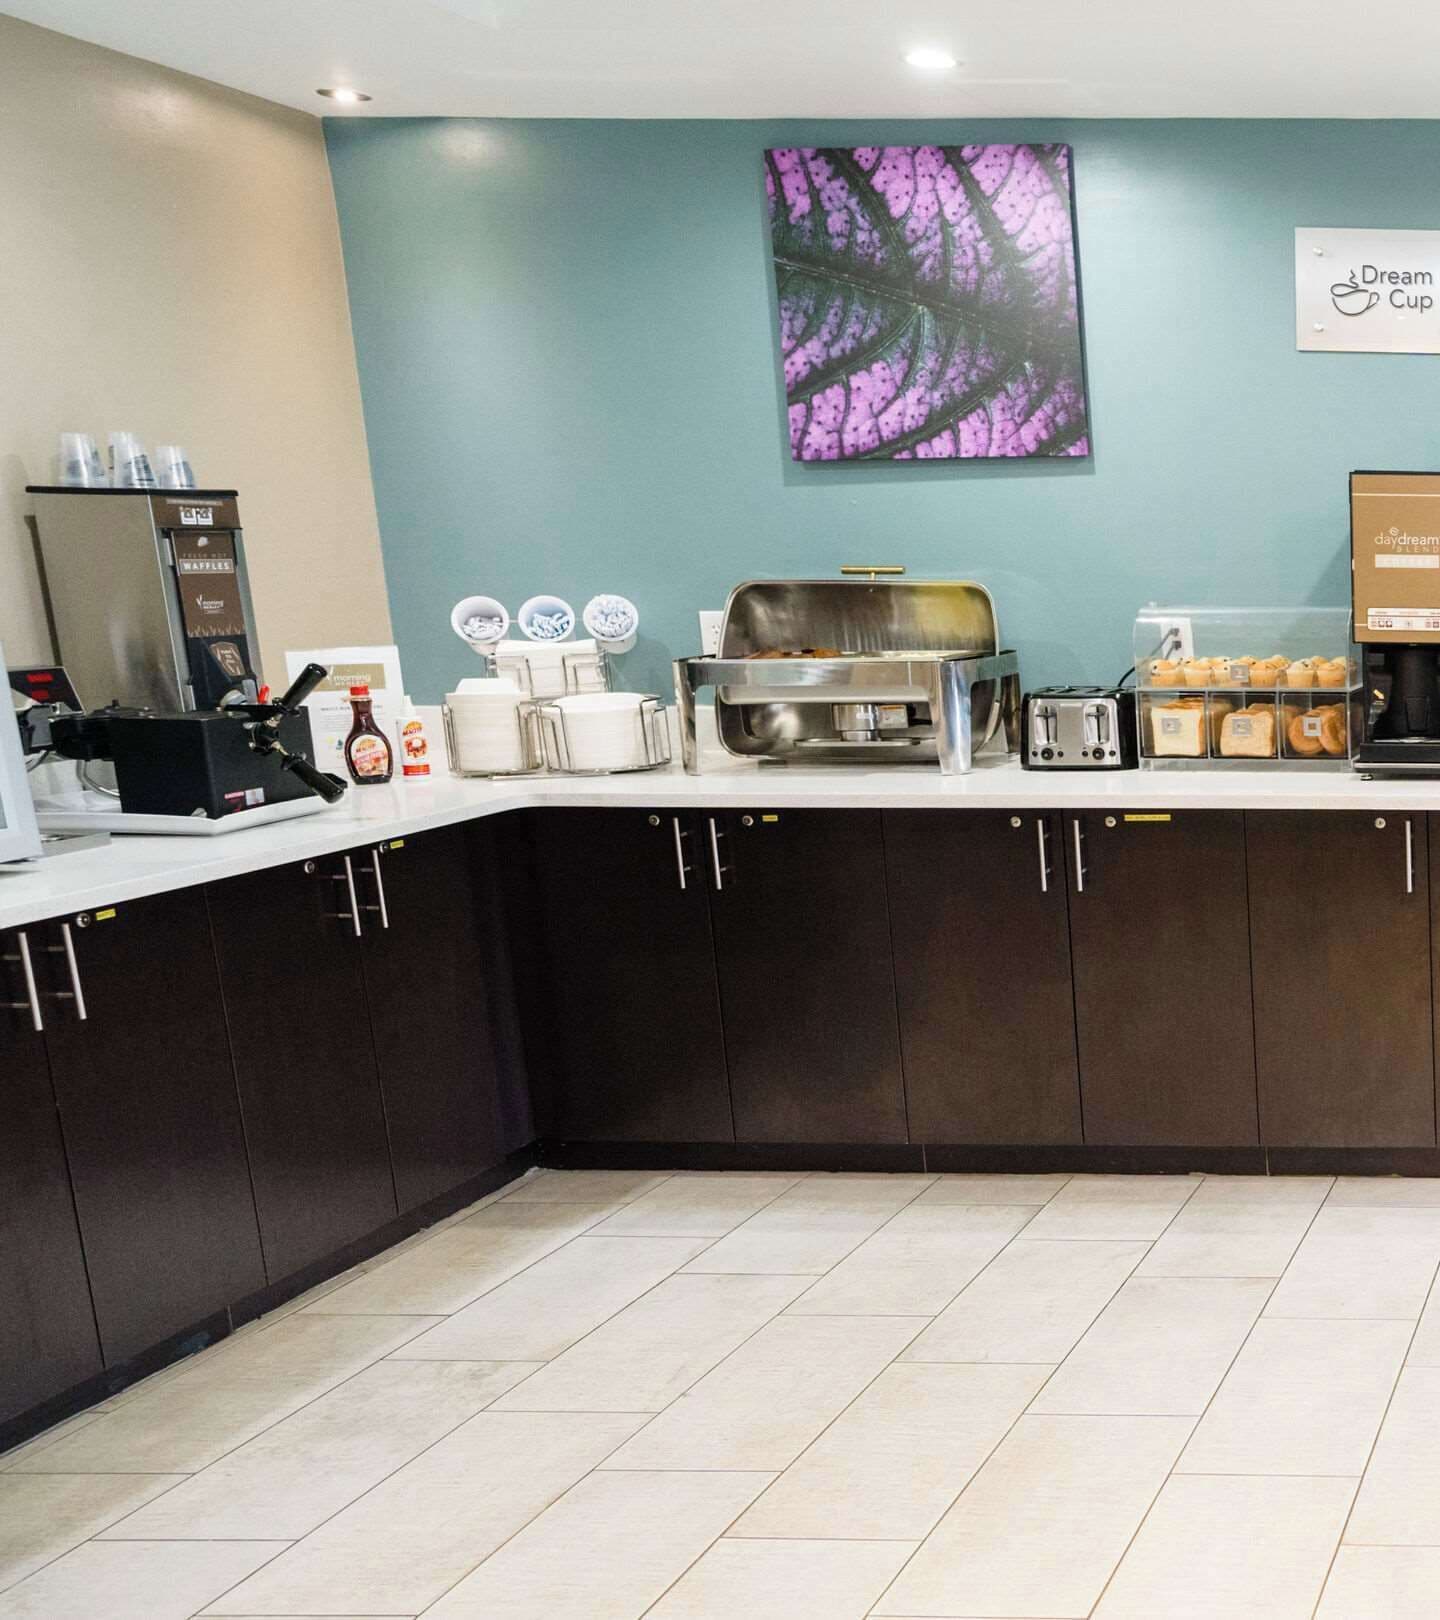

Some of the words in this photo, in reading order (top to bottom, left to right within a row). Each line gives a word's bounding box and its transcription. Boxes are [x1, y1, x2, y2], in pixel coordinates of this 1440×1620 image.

[1362, 264, 1433, 285] Dream
[1389, 288, 1433, 314] Cup
[1375, 531, 1440, 550] daydream
[1396, 545, 1440, 553] BLEND
[183, 561, 230, 571] WAFFLES
